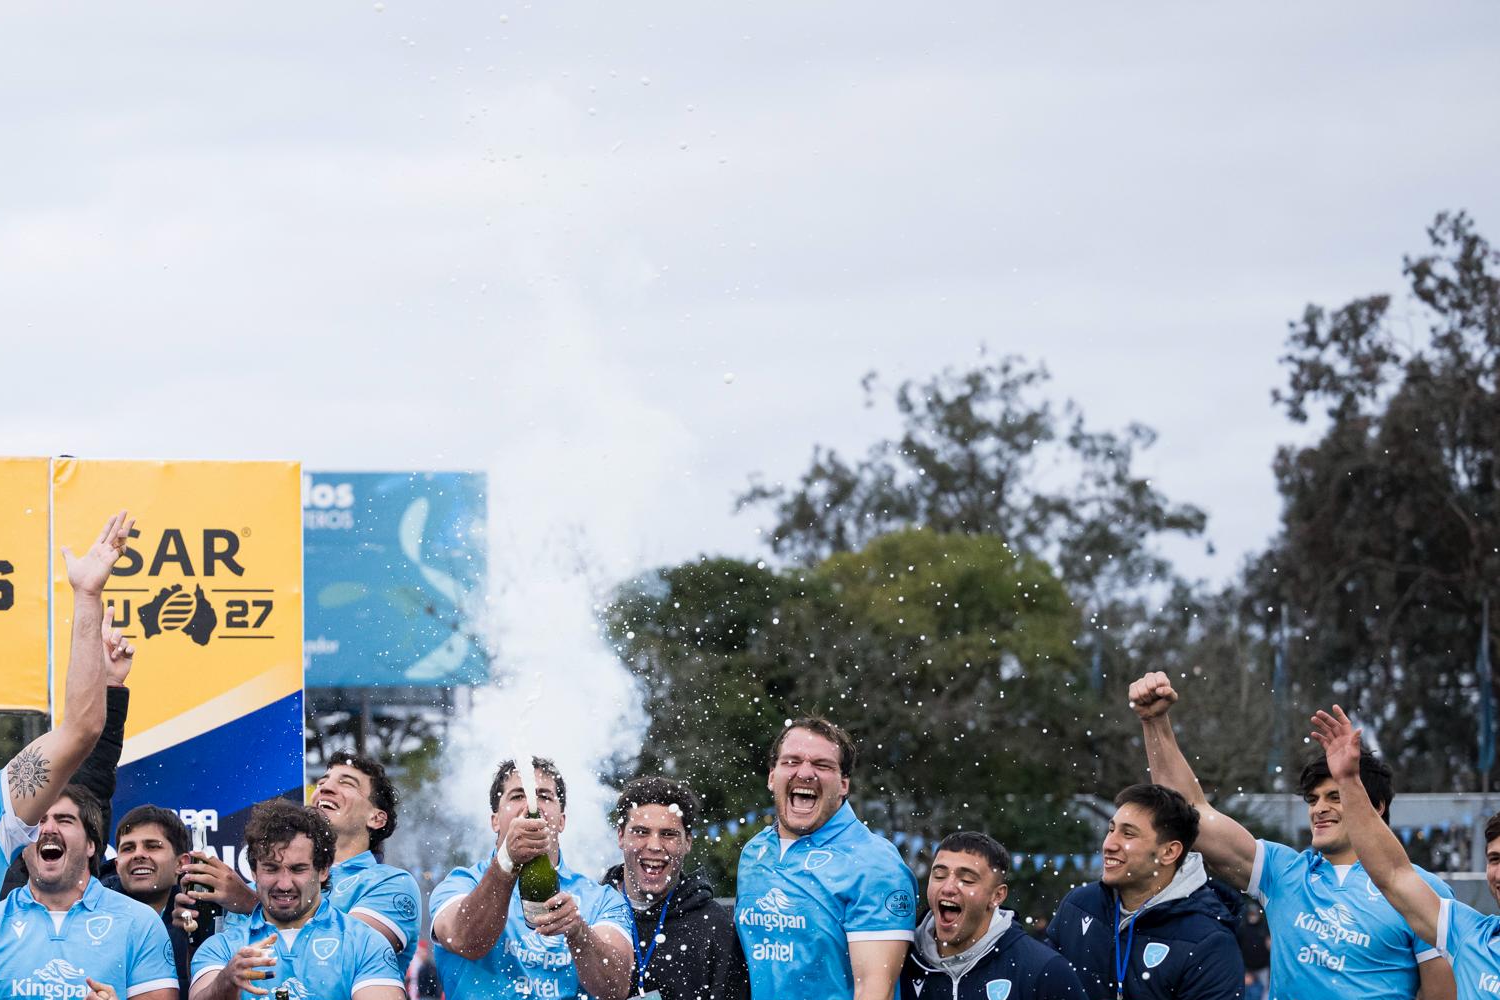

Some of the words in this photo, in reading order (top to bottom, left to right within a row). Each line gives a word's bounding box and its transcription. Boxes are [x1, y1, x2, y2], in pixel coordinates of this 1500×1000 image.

[102, 599, 130, 628] U
[226, 600, 273, 628] 27
[739, 907, 806, 932] Kingspan
[1294, 911, 1371, 947] Kingspan
[752, 938, 794, 961] antel
[1297, 944, 1346, 971] antel
